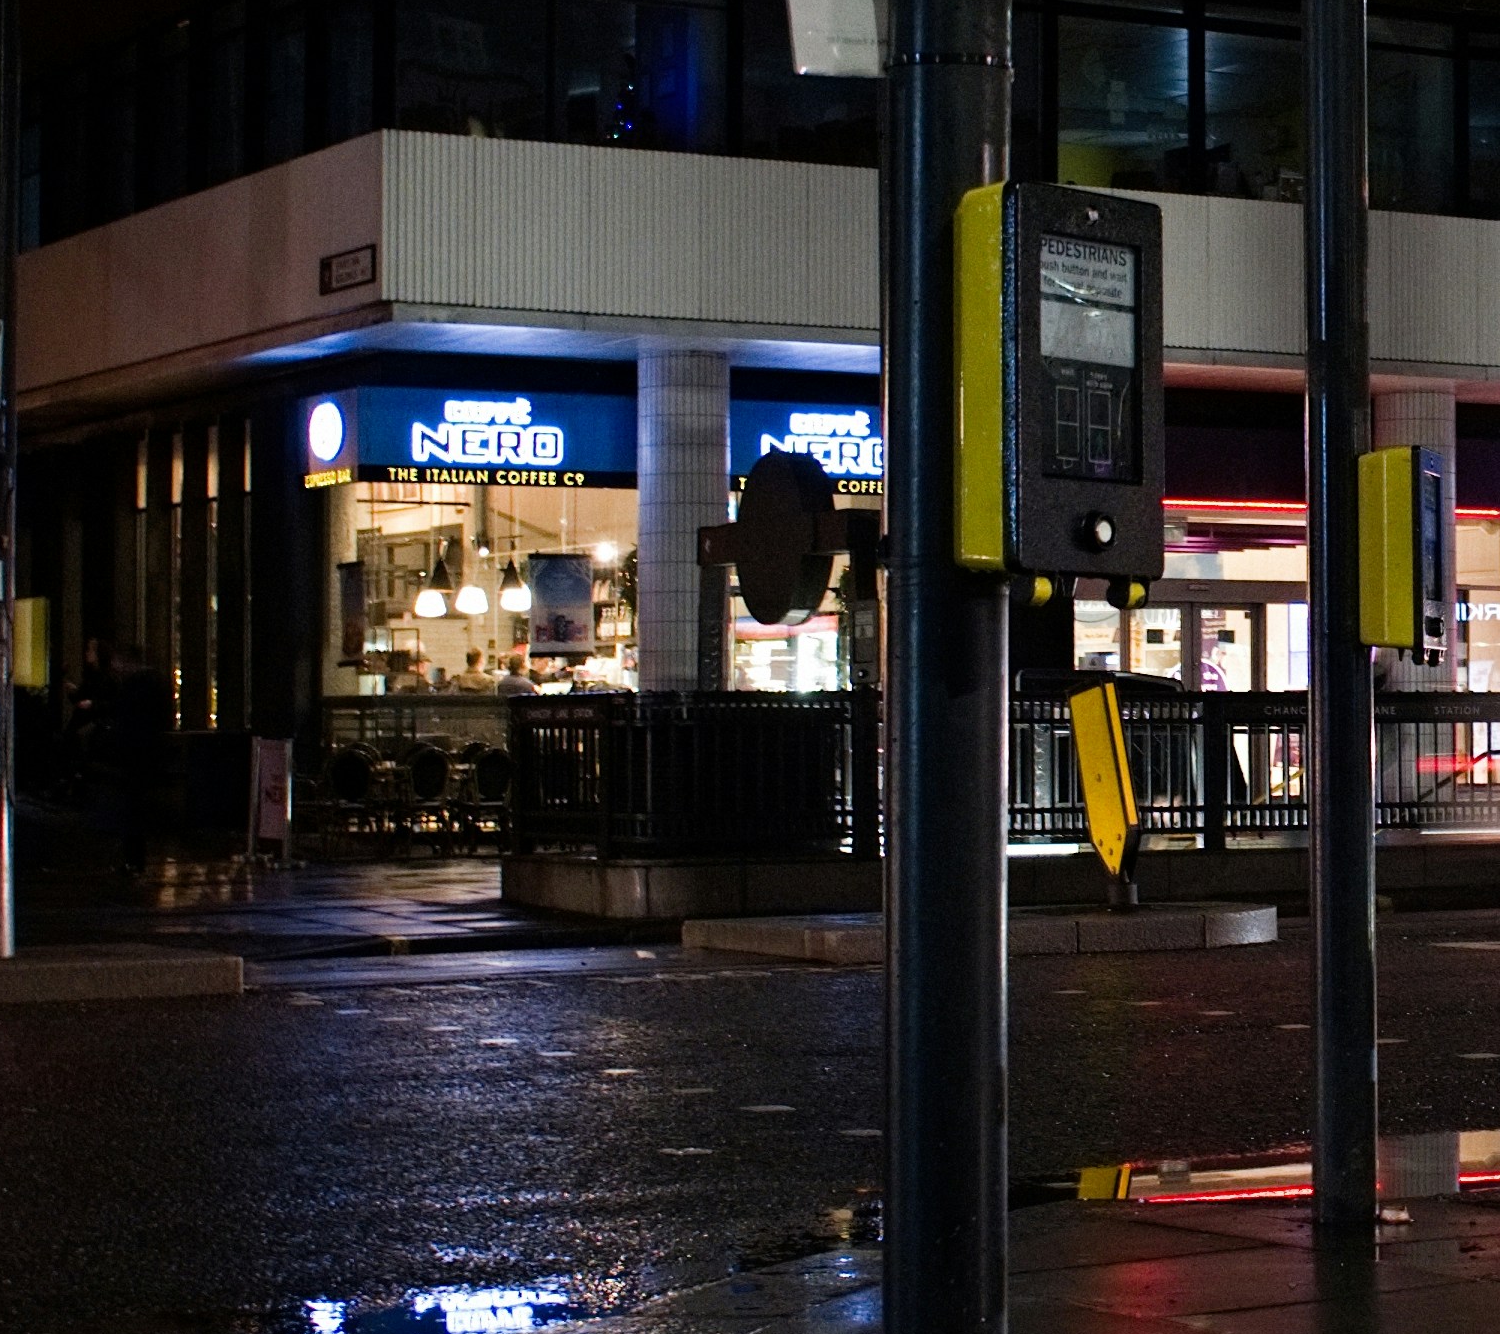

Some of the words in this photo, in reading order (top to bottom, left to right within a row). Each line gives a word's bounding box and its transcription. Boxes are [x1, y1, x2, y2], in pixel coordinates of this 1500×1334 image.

[1040, 237, 1127, 267] PEDESTRIANS
[412, 422, 564, 466] NERO
[388, 467, 418, 482] THE
[426, 468, 489, 484] ITALIAN
[496, 470, 557, 485] COFFEE
[837, 479, 883, 493] COFFE
[1263, 705, 1307, 716] CHANC
[1374, 705, 1397, 716] ANE
[1434, 705, 1481, 716] STATION
